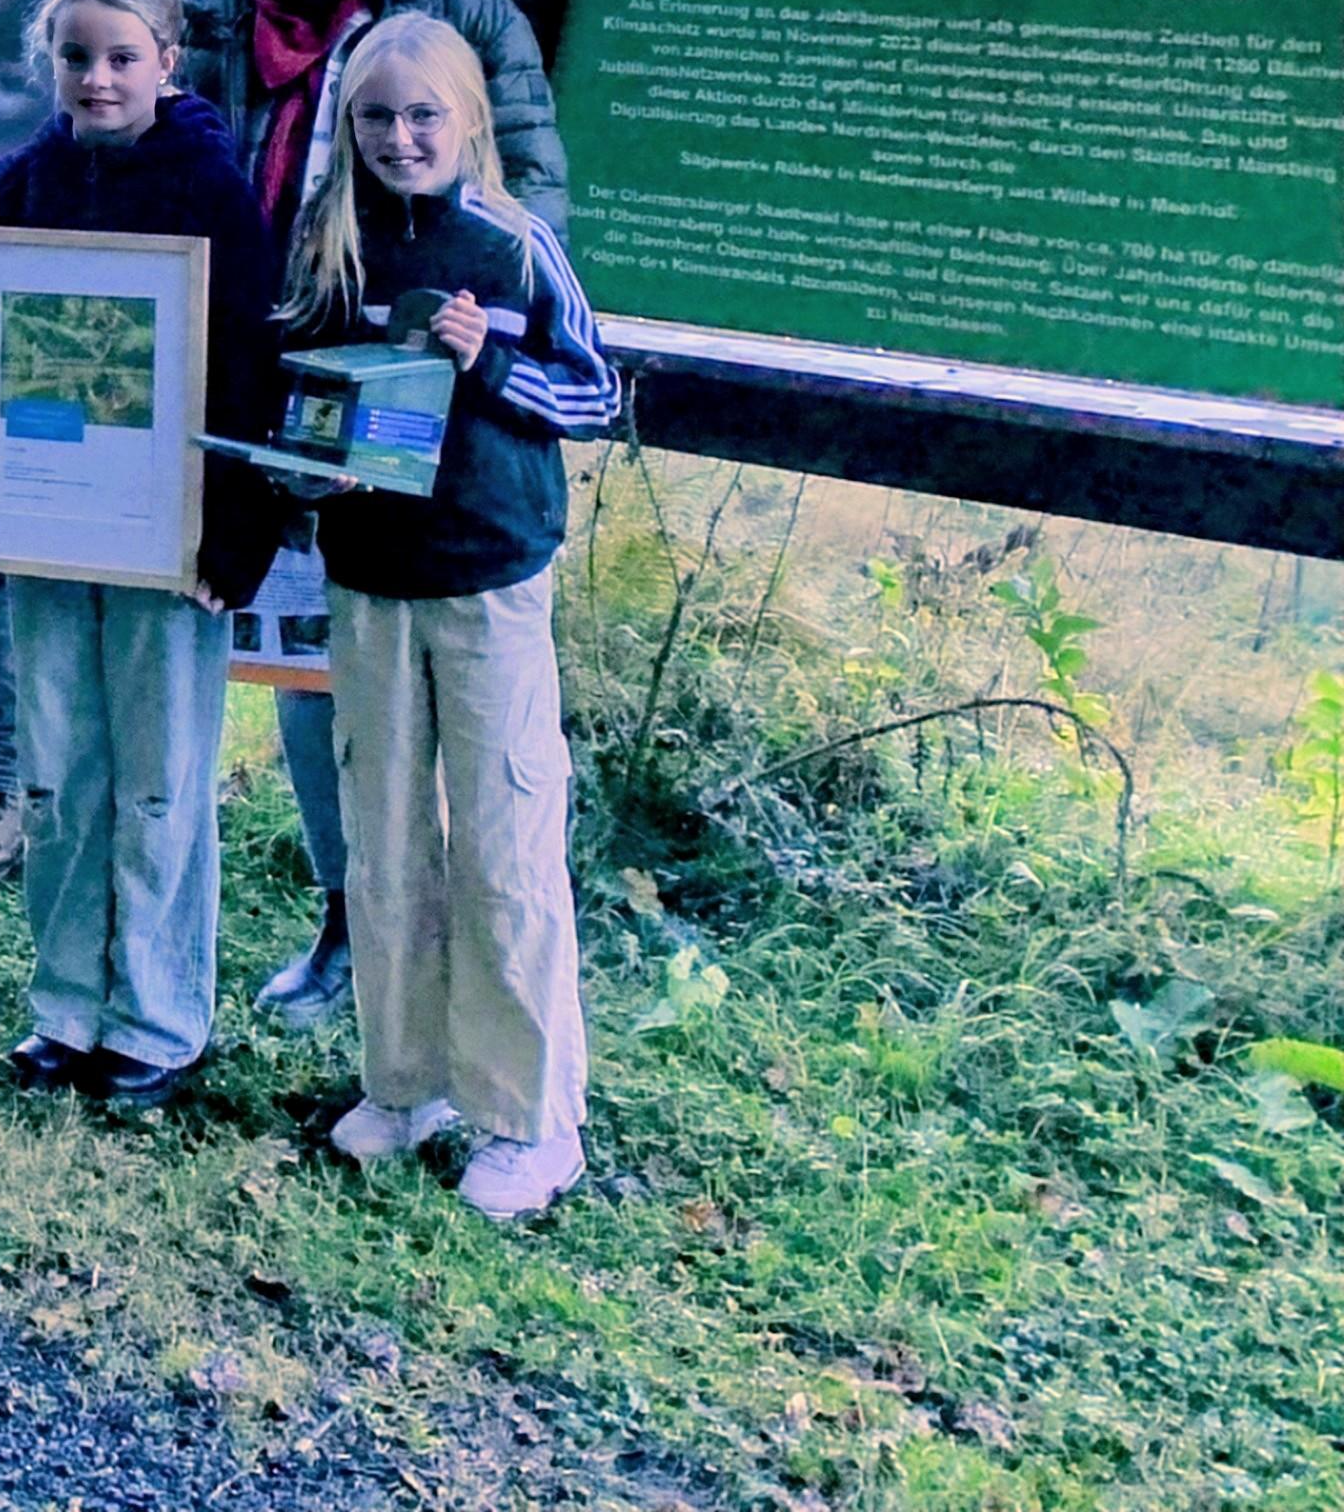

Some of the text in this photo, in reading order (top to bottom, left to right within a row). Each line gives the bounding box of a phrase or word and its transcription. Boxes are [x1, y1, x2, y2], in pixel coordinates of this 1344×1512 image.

[603, 16, 700, 35] Klimaschutz
[706, 25, 752, 38] wurde
[762, 27, 780, 40] im
[786, 29, 874, 46] November
[926, 38, 981, 54] dieser
[986, 42, 1168, 66] Mischwaldbestand
[1174, 56, 1205, 69] mit
[1213, 57, 1260, 72] 1250
[659, 0, 749, 20] Erinnerung
[754, 8, 774, 18] an
[779, 6, 808, 20] das
[816, 8, 940, 30] Jubiläumsjahr
[945, 18, 981, 30] und
[986, 19, 1013, 32] als
[1019, 24, 1152, 41] gemeinsames
[1159, 30, 1239, 47] Zeichen
[1245, 35, 1274, 49] für
[1280, 37, 1322, 52] den
[652, 45, 1288, 99] von zahlreichen Familien und Einzelpersonen unter Federführung des
[777, 73, 816, 88] 2022
[822, 79, 902, 95] gepflanzt
[907, 85, 942, 98] und
[946, 86, 1006, 103] dieses
[1012, 92, 1072, 108] Schild
[1173, 105, 1286, 125] Unterstützt
[610, 103, 726, 128] Digitalisierung
[765, 116, 826, 133] Landes
[1028, 139, 1082, 155] durch
[1089, 145, 1125, 159] den
[1132, 148, 1230, 169] Stadtforst
[648, 84, 689, 99] diese
[694, 88, 746, 104] Aktion
[751, 92, 800, 108] durch
[805, 97, 836, 111] das
[842, 100, 946, 120] Ministerium
[951, 109, 978, 123] für
[1200, 130, 1241, 144] Bau
[1247, 136, 1286, 148] und
[680, 152, 768, 172] Sägewerke
[838, 167, 853, 180] in
[858, 169, 1002, 199] Niedermarsberg
[1008, 186, 1044, 199] und
[1126, 195, 1144, 208] in
[872, 152, 1014, 173] sowie durch die
[588, 185, 614, 199] Der
[620, 188, 750, 216] Obermarsberger
[756, 203, 838, 224] Stadtwald
[844, 213, 888, 229] hatte
[893, 220, 921, 233] mit
[926, 223, 971, 238] einer
[977, 227, 1039, 245] Fläche
[1045, 238, 1080, 250] von
[1086, 242, 1114, 254] ca.
[1160, 247, 1184, 261] ha
[1189, 250, 1220, 265] für
[1226, 254, 1257, 269] die
[609, 209, 723, 237] Obermarsberg
[728, 223, 762, 237] eine
[767, 226, 809, 243] hohe
[815, 233, 943, 258] wirtschaftliche
[1062, 258, 1106, 276] Über
[1114, 266, 1247, 292] Jahrhunderte
[1254, 282, 1326, 301] lieferte
[582, 246, 635, 266] Folgen
[672, 258, 784, 283] Klimawandels
[906, 290, 934, 301] um
[940, 294, 1015, 312] unseren
[1021, 302, 1154, 329] Nachkommen
[1160, 320, 1202, 335] eine
[1208, 325, 1277, 345] intakte
[604, 229, 626, 243] die
[632, 232, 710, 253] Bewohner
[716, 243, 844, 272] Obermarsbergs
[904, 268, 936, 280] und
[1049, 283, 1113, 302] Setzen
[1120, 293, 1148, 306] wir
[1155, 299, 1191, 311] uns
[1198, 301, 1252, 319] dafür
[1302, 314, 1334, 328] die
[866, 308, 886, 319] zu
